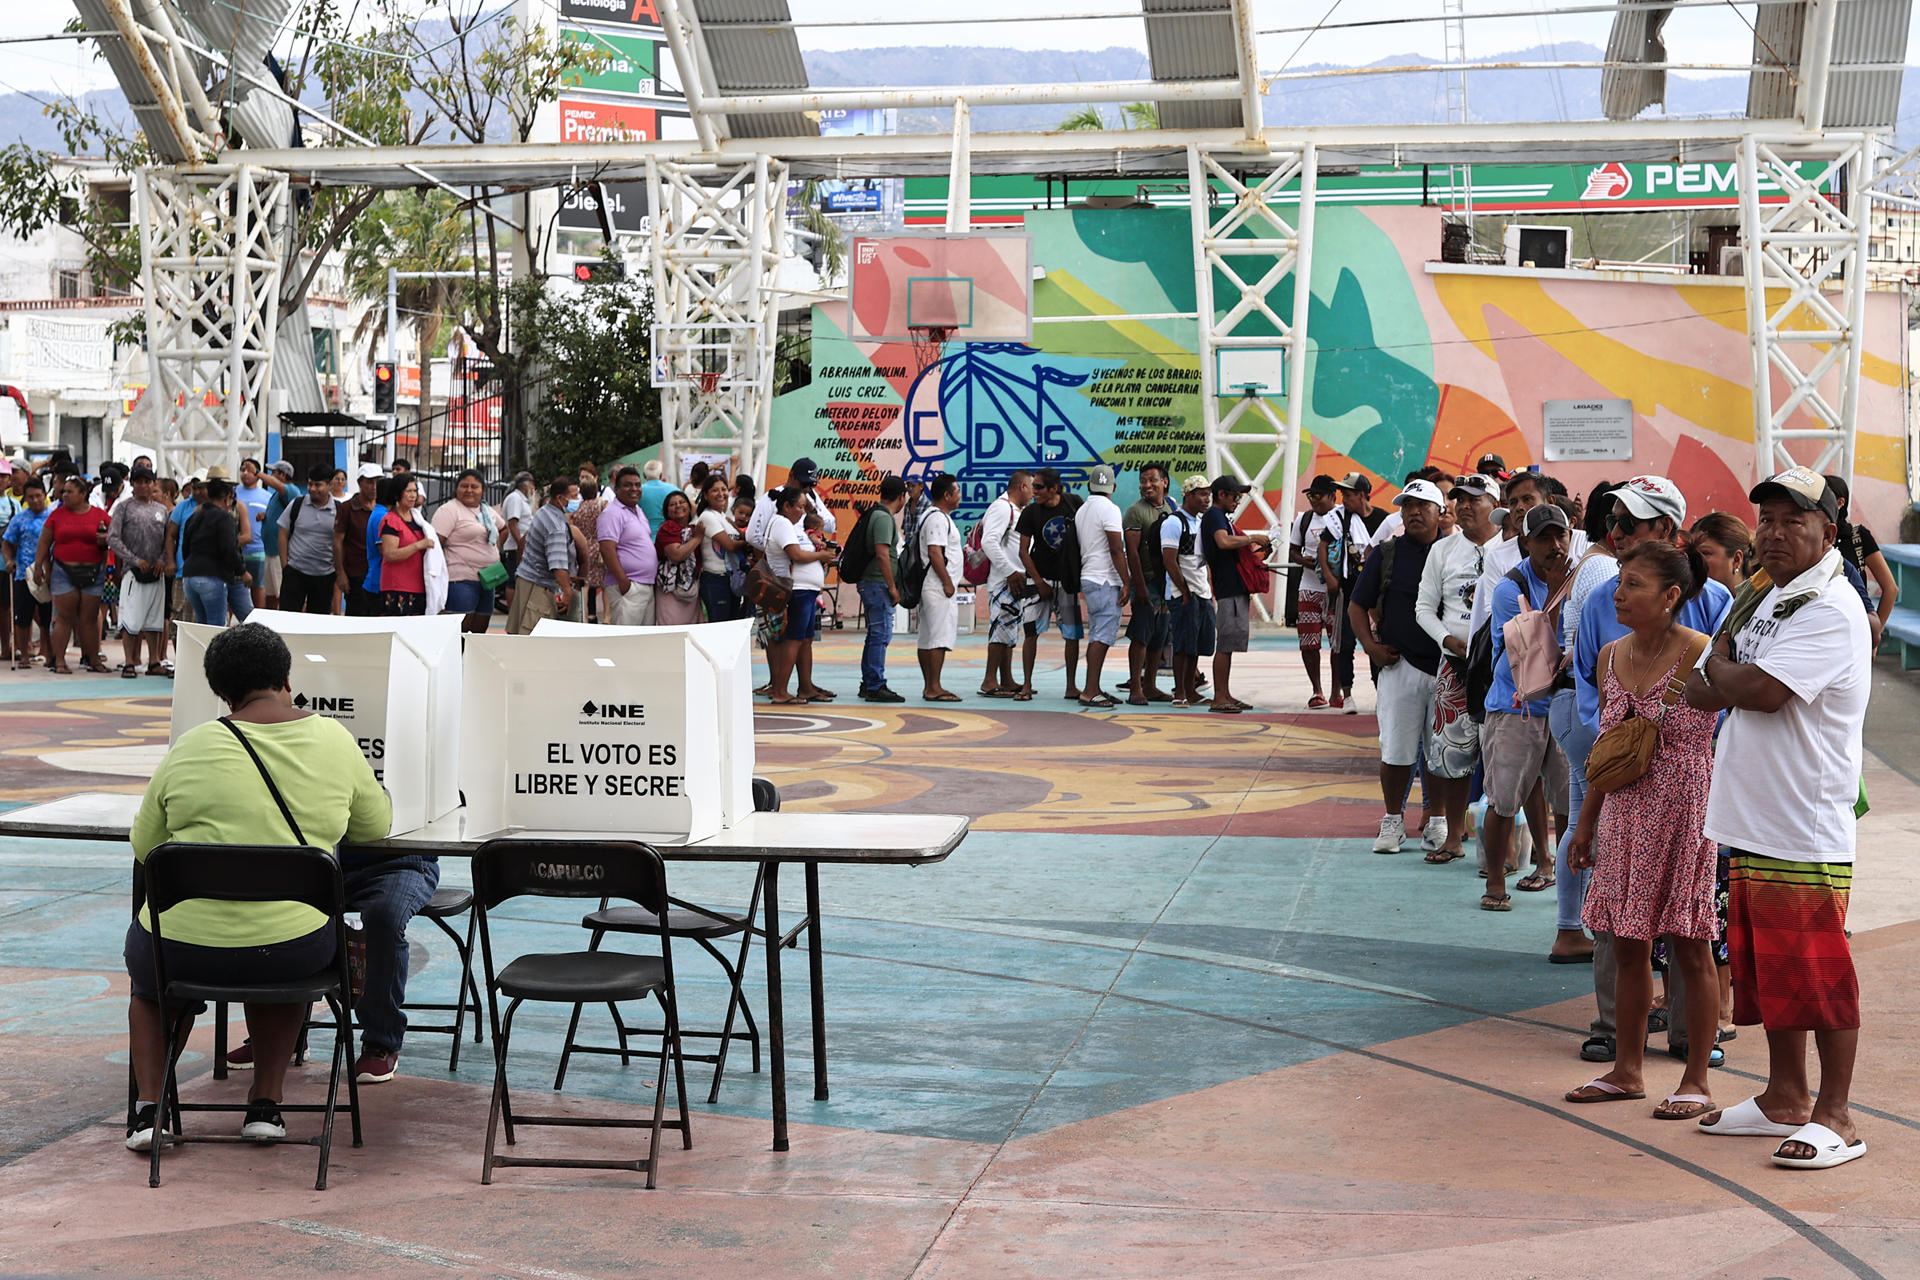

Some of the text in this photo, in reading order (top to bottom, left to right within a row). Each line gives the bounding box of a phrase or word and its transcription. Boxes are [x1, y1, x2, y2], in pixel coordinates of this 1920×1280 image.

[564, 109, 596, 119] PEMEX
[819, 366, 871, 378] ABRAHAM
[1100, 369, 1133, 379] VECINOS
[1136, 368, 1146, 379] DE
[1148, 369, 1164, 379] LOS
[828, 386, 887, 398] LUIS CRUZ.
[1090, 383, 1199, 395] DE LA PLAYA CANDELARIA
[1090, 397, 1172, 407] PINZONA Y RINCON
[814, 407, 899, 419] EMETERIO DELOYA
[1115, 431, 1155, 440] VALENCIA
[1156, 431, 1168, 440] DE
[814, 438, 902, 449] ARTEMIO CARDENAS
[1114, 444, 1176, 454] ORGANIZADORA
[817, 469, 852, 480] ADRIAN
[832, 483, 881, 495] CARDENAS
[962, 483, 988, 502] LA
[824, 498, 850, 509] FRANK
[311, 697, 354, 712] INE
[601, 704, 645, 718] INE
[547, 742, 677, 766] EL VOTO ES
[515, 773, 578, 795] LIBRE
[584, 774, 599, 795] Y
